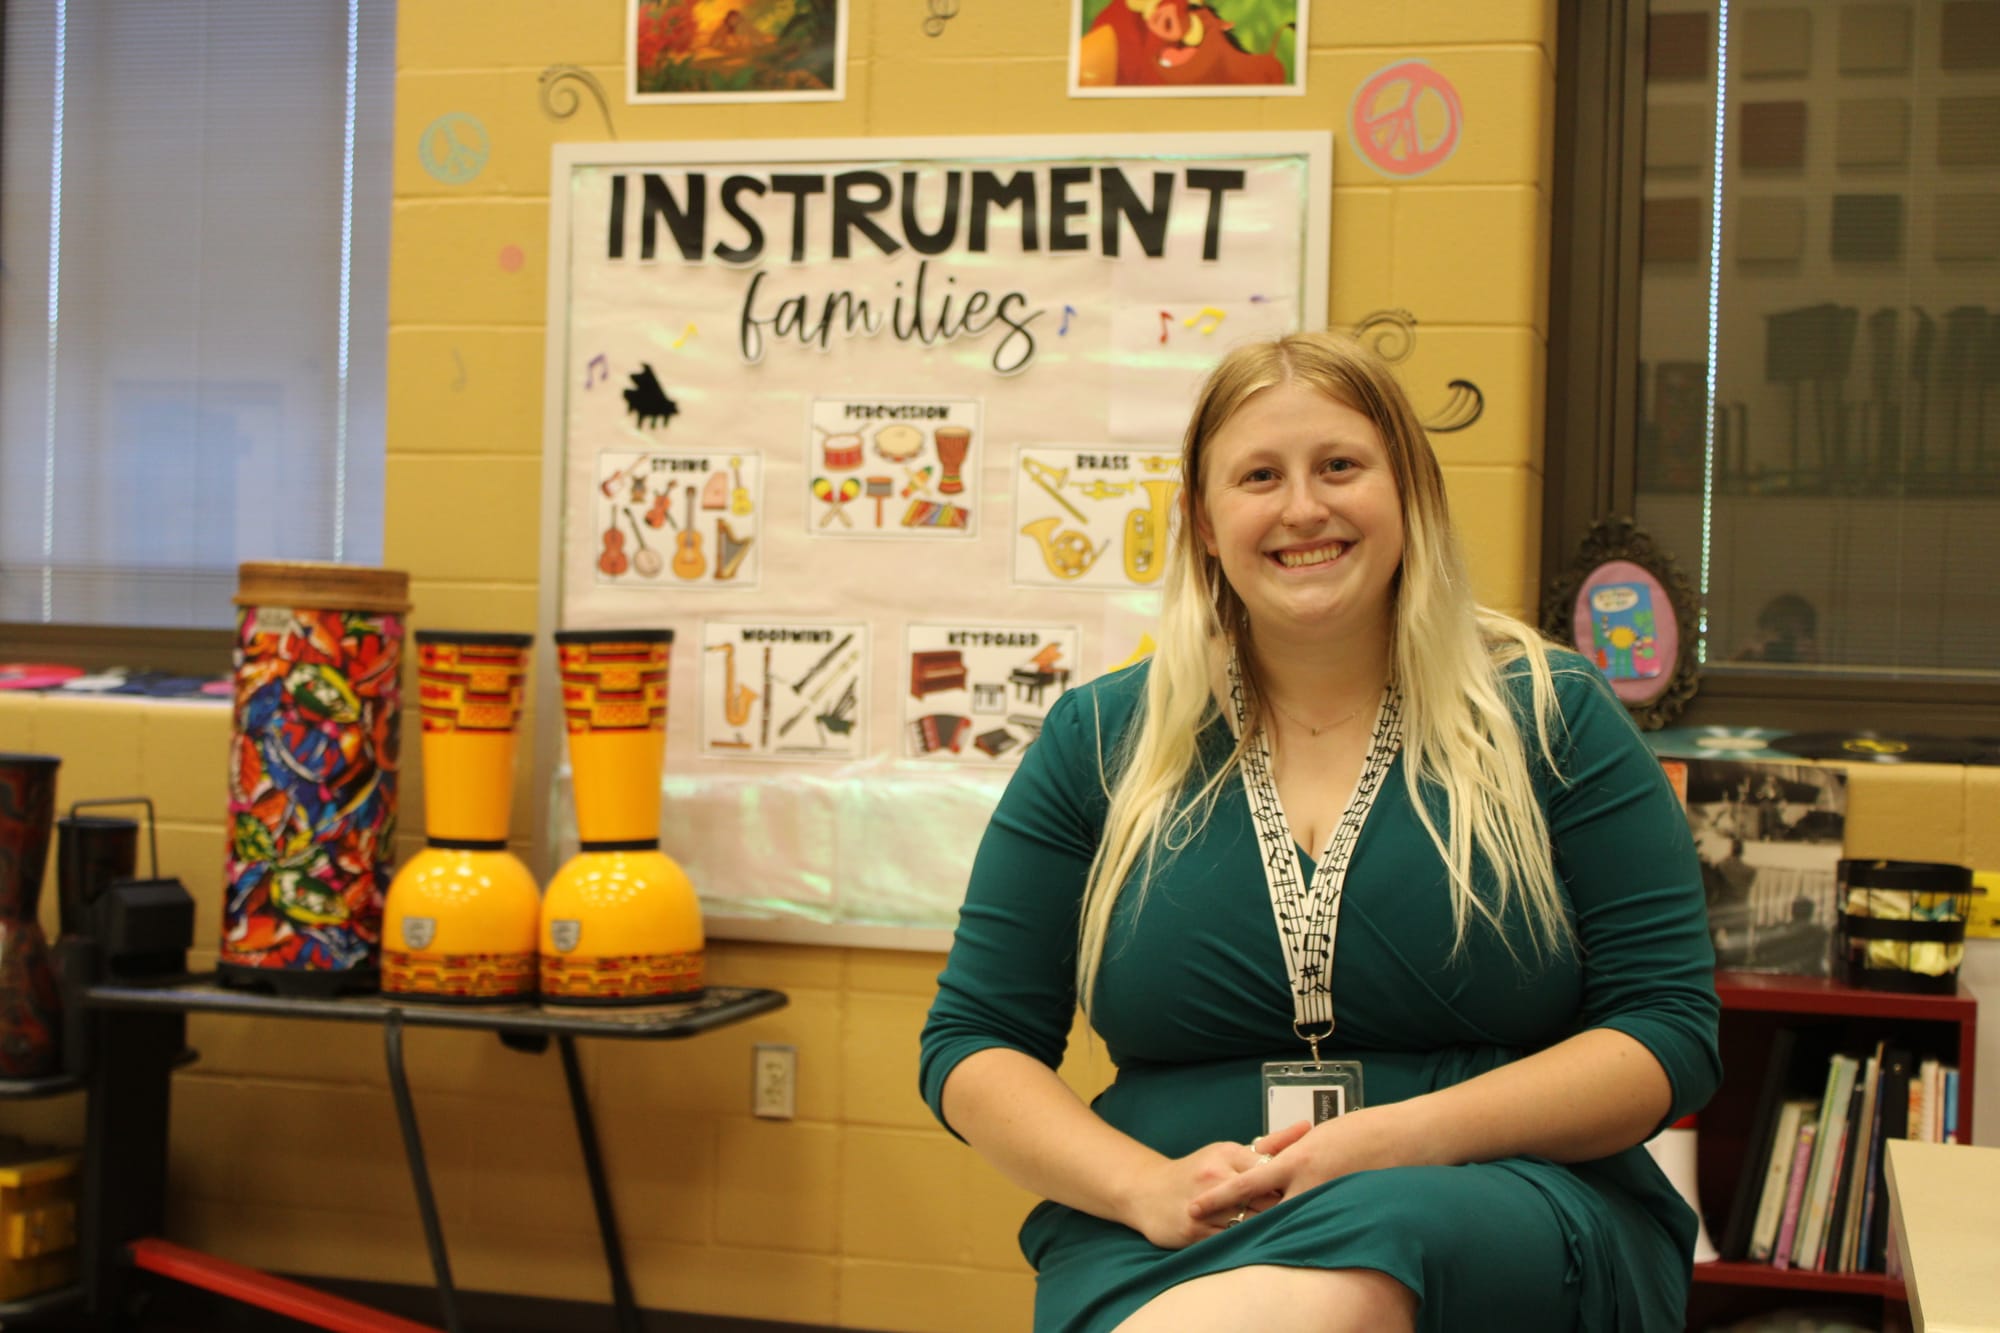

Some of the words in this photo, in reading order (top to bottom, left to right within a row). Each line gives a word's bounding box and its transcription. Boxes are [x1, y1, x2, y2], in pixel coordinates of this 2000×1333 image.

[608, 167, 1246, 263] INSTRUMENT
[741, 261, 1046, 373] families
[844, 404, 950, 420] PERCUSSION
[1077, 454, 1129, 471] BRASS
[742, 628, 833, 643] WOODWIND
[948, 630, 1040, 648] KEYBOARD
